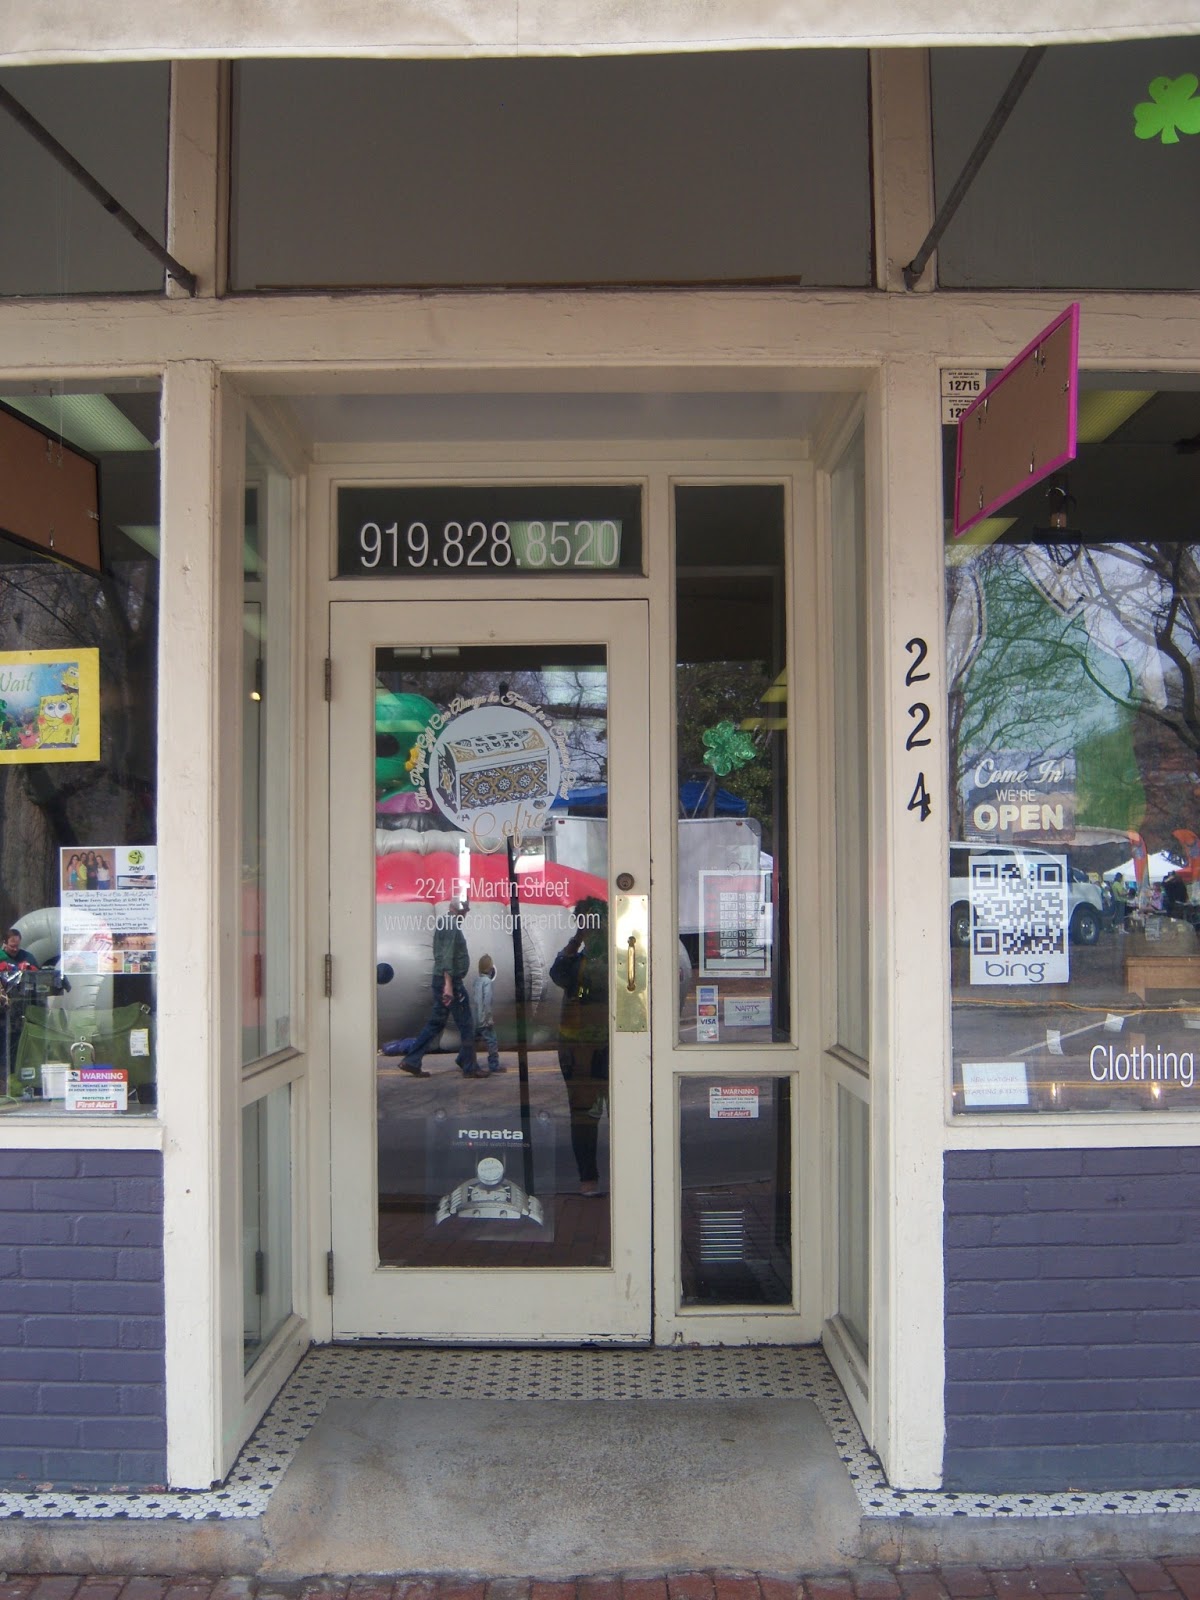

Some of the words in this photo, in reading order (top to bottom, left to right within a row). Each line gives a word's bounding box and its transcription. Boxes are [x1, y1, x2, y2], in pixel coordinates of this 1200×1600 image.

[948, 380, 980, 391] 12715
[360, 520, 619, 568] 919.828.8520
[905, 637, 931, 822] 224
[974, 758, 1029, 788] Come
[1033, 759, 1065, 784] In
[995, 789, 1036, 802] WE'RE
[467, 803, 546, 854] Cofre
[973, 804, 1064, 831] OPEN
[415, 877, 446, 899] 224
[470, 877, 518, 898] Martin
[523, 876, 570, 898] Street
[383, 911, 601, 935] www.cofreconsignment.com
[985, 960, 1046, 983] bing
[82, 1072, 124, 1080] WARNING
[1089, 1044, 1194, 1088] Clothing
[458, 1129, 524, 1140] renata
